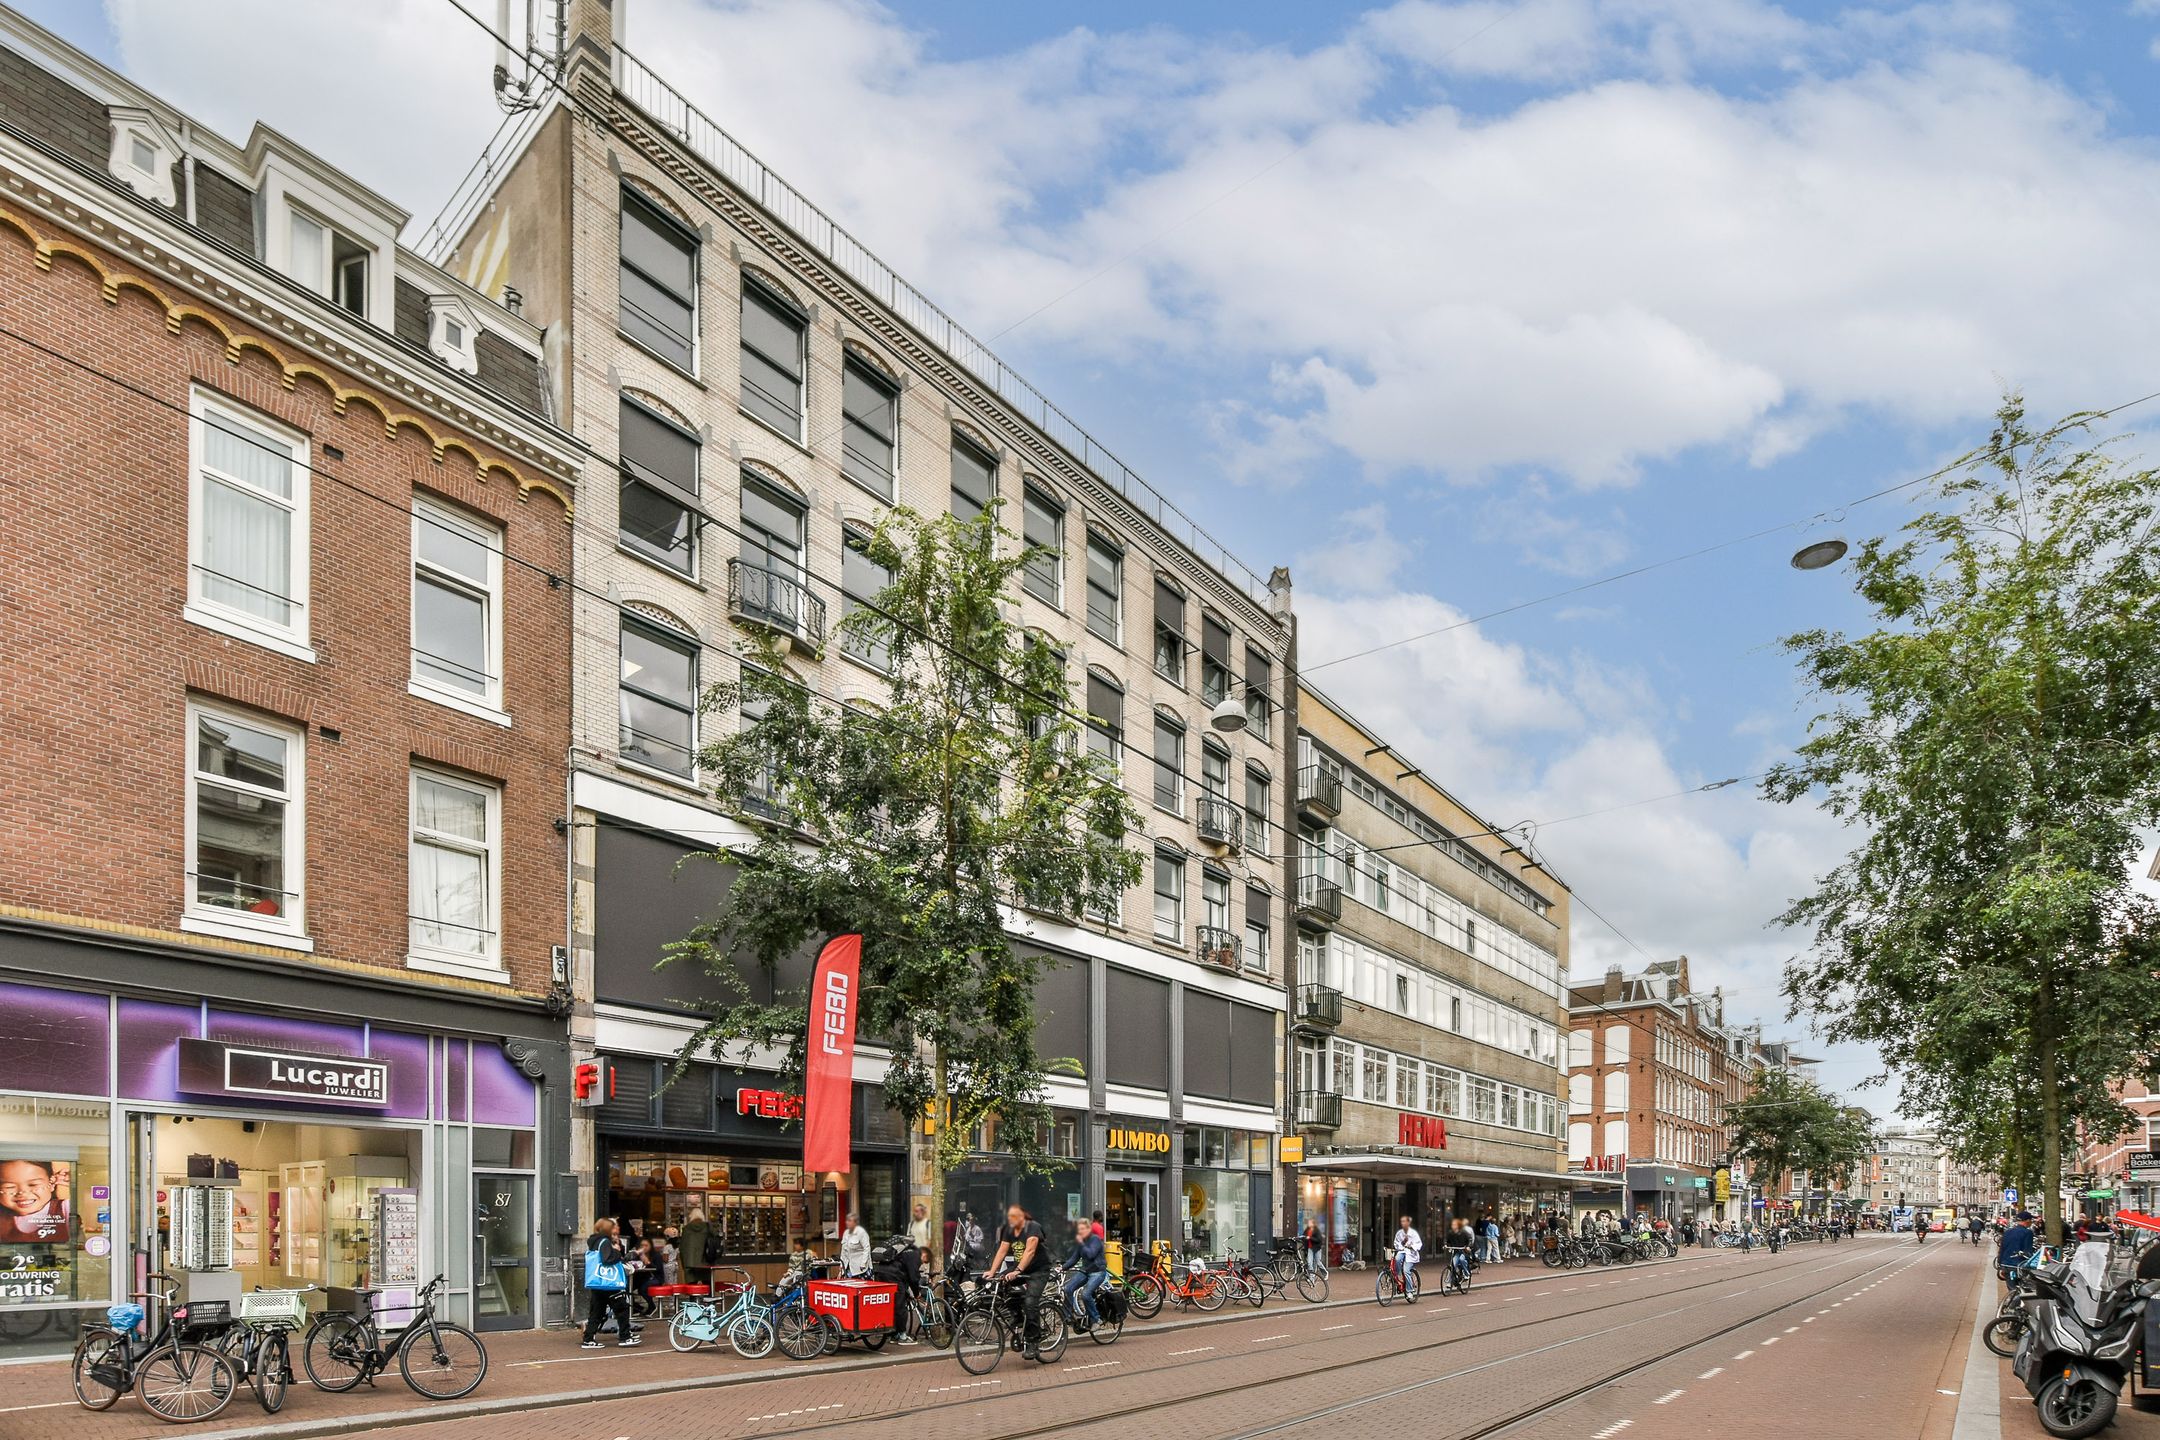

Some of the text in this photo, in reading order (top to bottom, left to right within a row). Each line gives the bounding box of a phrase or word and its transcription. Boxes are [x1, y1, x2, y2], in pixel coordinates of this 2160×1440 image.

[823, 971, 848, 1055] FEBO
[271, 1060, 380, 1090] Lucardi
[575, 1064, 600, 1099] F
[324, 1086, 381, 1098] JUWELIER
[1107, 1128, 1170, 1153] JUMBO
[1398, 1112, 1447, 1150] HEMA
[495, 1193, 512, 1207] 87
[814, 1291, 890, 1310] FEBO FEBO
